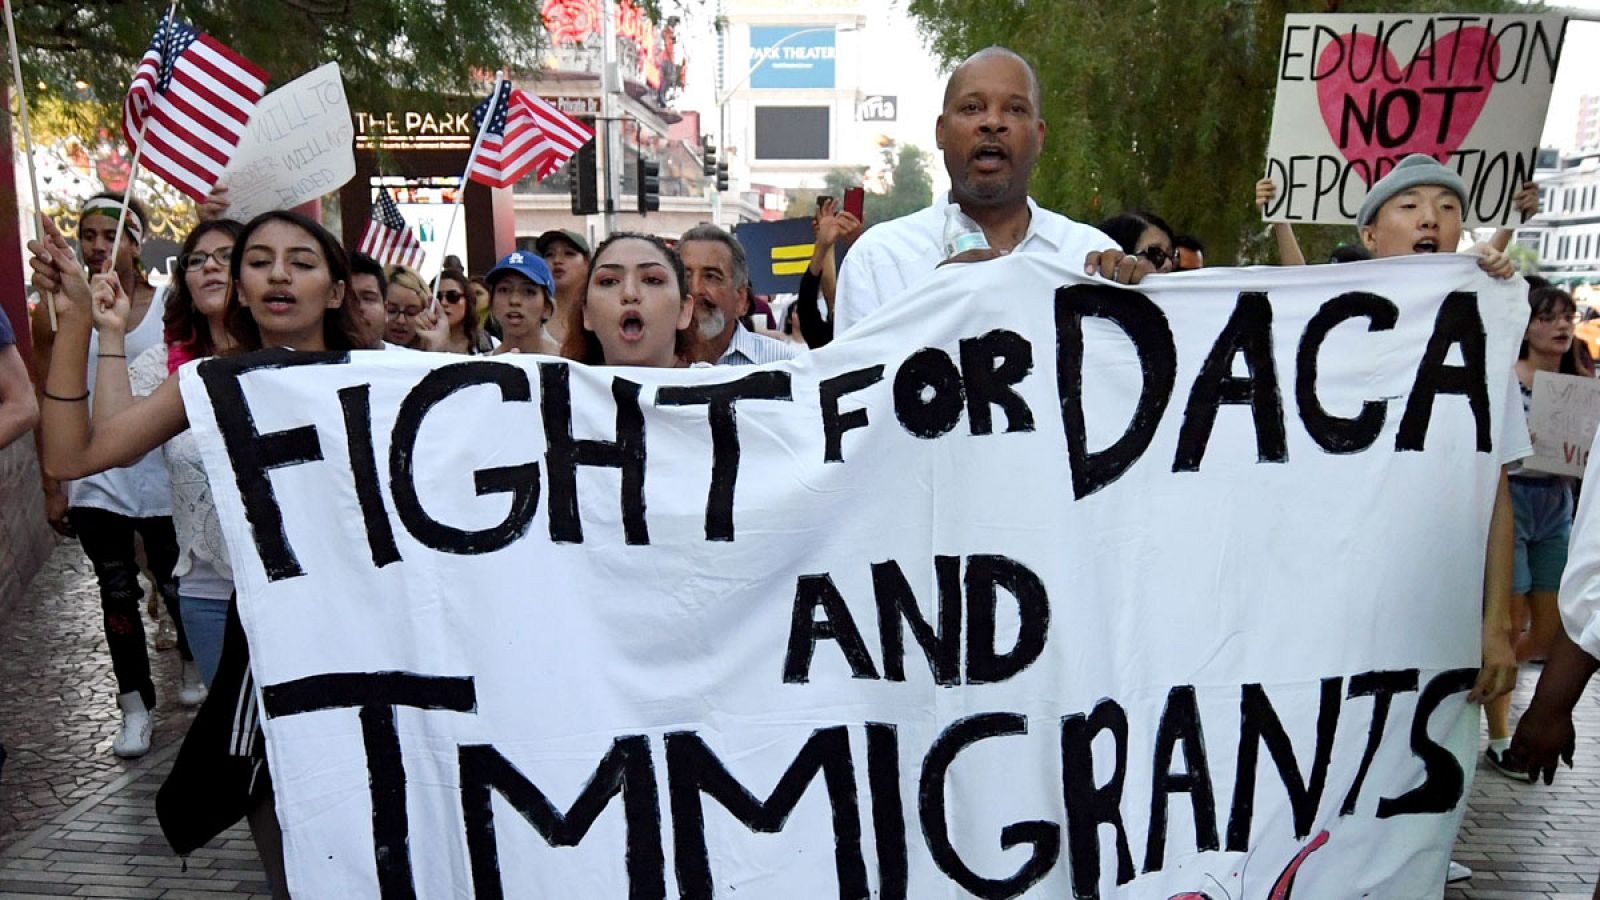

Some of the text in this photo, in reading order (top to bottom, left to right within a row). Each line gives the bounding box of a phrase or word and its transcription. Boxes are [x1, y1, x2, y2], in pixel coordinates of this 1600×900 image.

[1281, 16, 1569, 84] EDUCATION
[306, 80, 342, 113] TO
[355, 112, 471, 134] THE PARK
[1339, 86, 1483, 149] NOT
[1263, 147, 1537, 225] DEPOTION
[196, 283, 1492, 582] FIGHT FOR DACA
[783, 553, 1050, 688] AND
